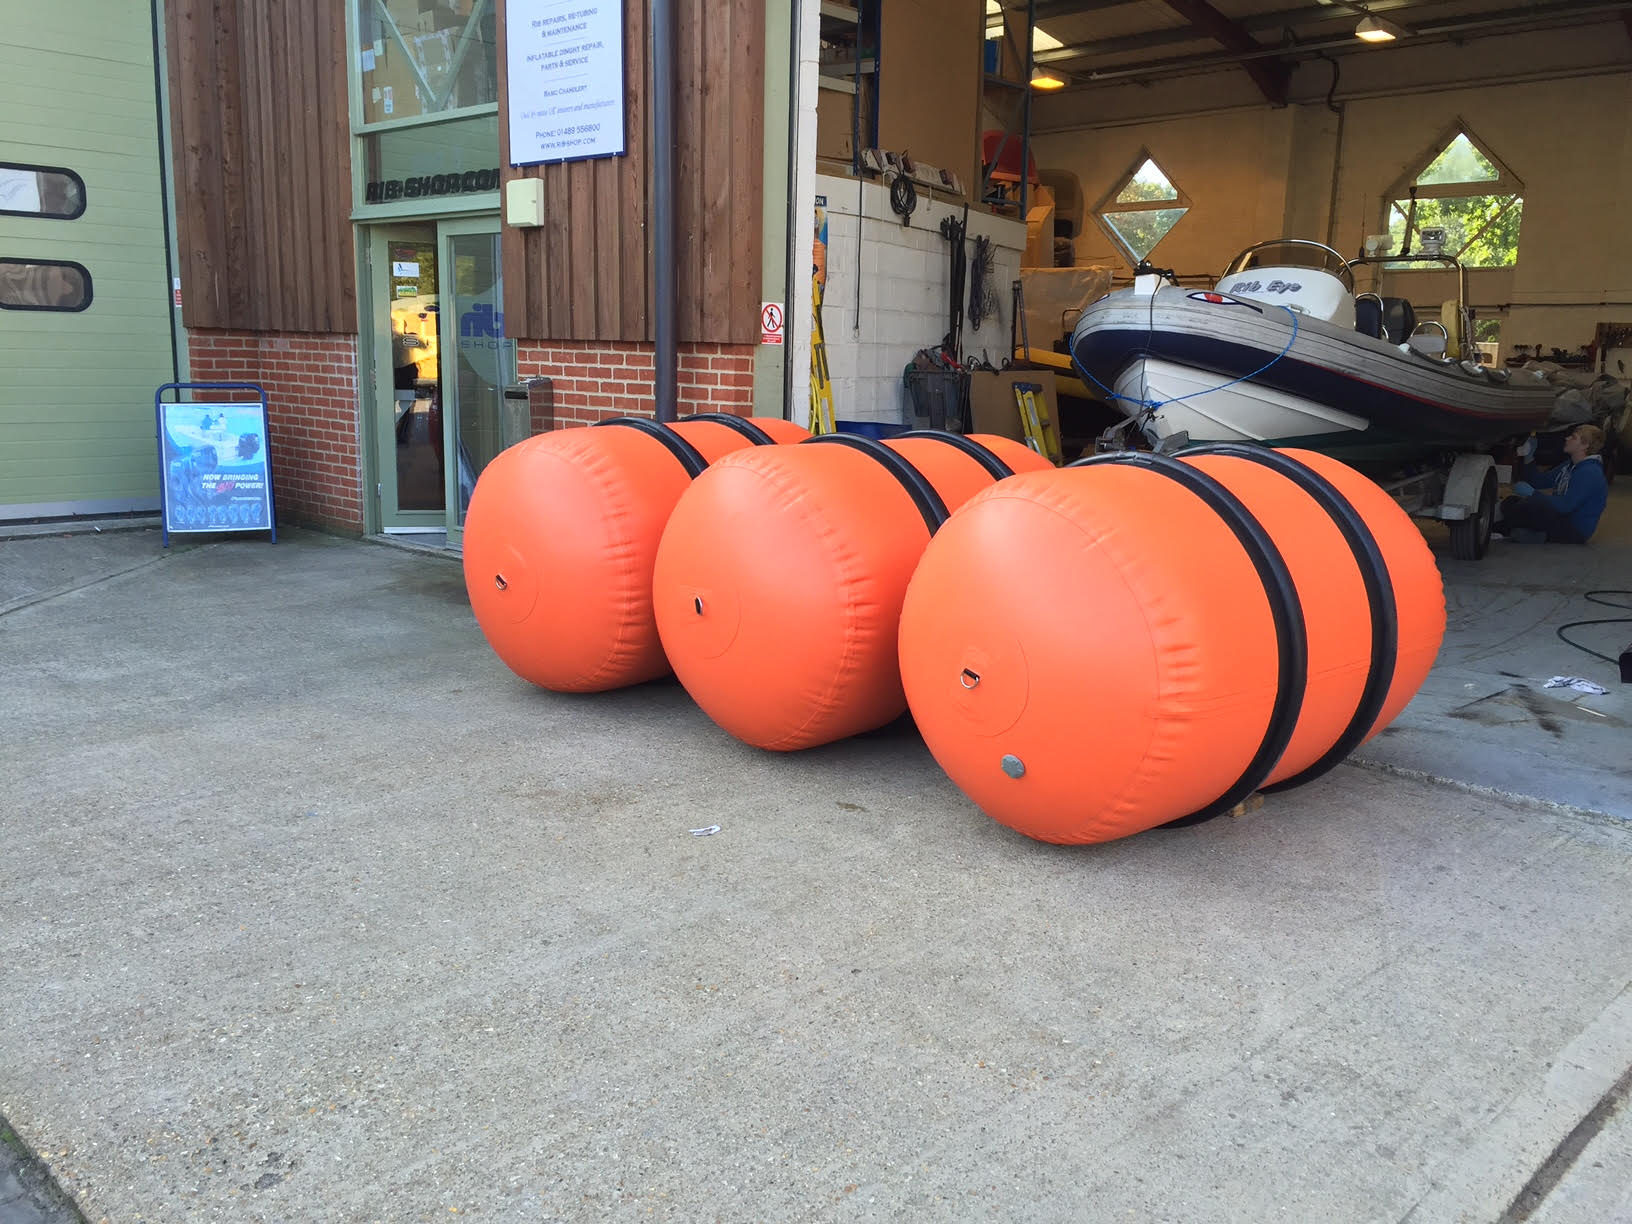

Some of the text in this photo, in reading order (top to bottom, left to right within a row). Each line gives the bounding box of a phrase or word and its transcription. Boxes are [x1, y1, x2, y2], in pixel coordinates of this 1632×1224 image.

[547, 22, 588, 36] MAINTENANCE
[526, 49, 558, 62] INFLATABLE
[541, 62, 558, 71] PARTS
[564, 56, 588, 67] SERVICE
[557, 126, 575, 136] 01489
[1230, 280, 1302, 294] Rib Eye
[203, 473, 259, 481] NOW BRINGING
